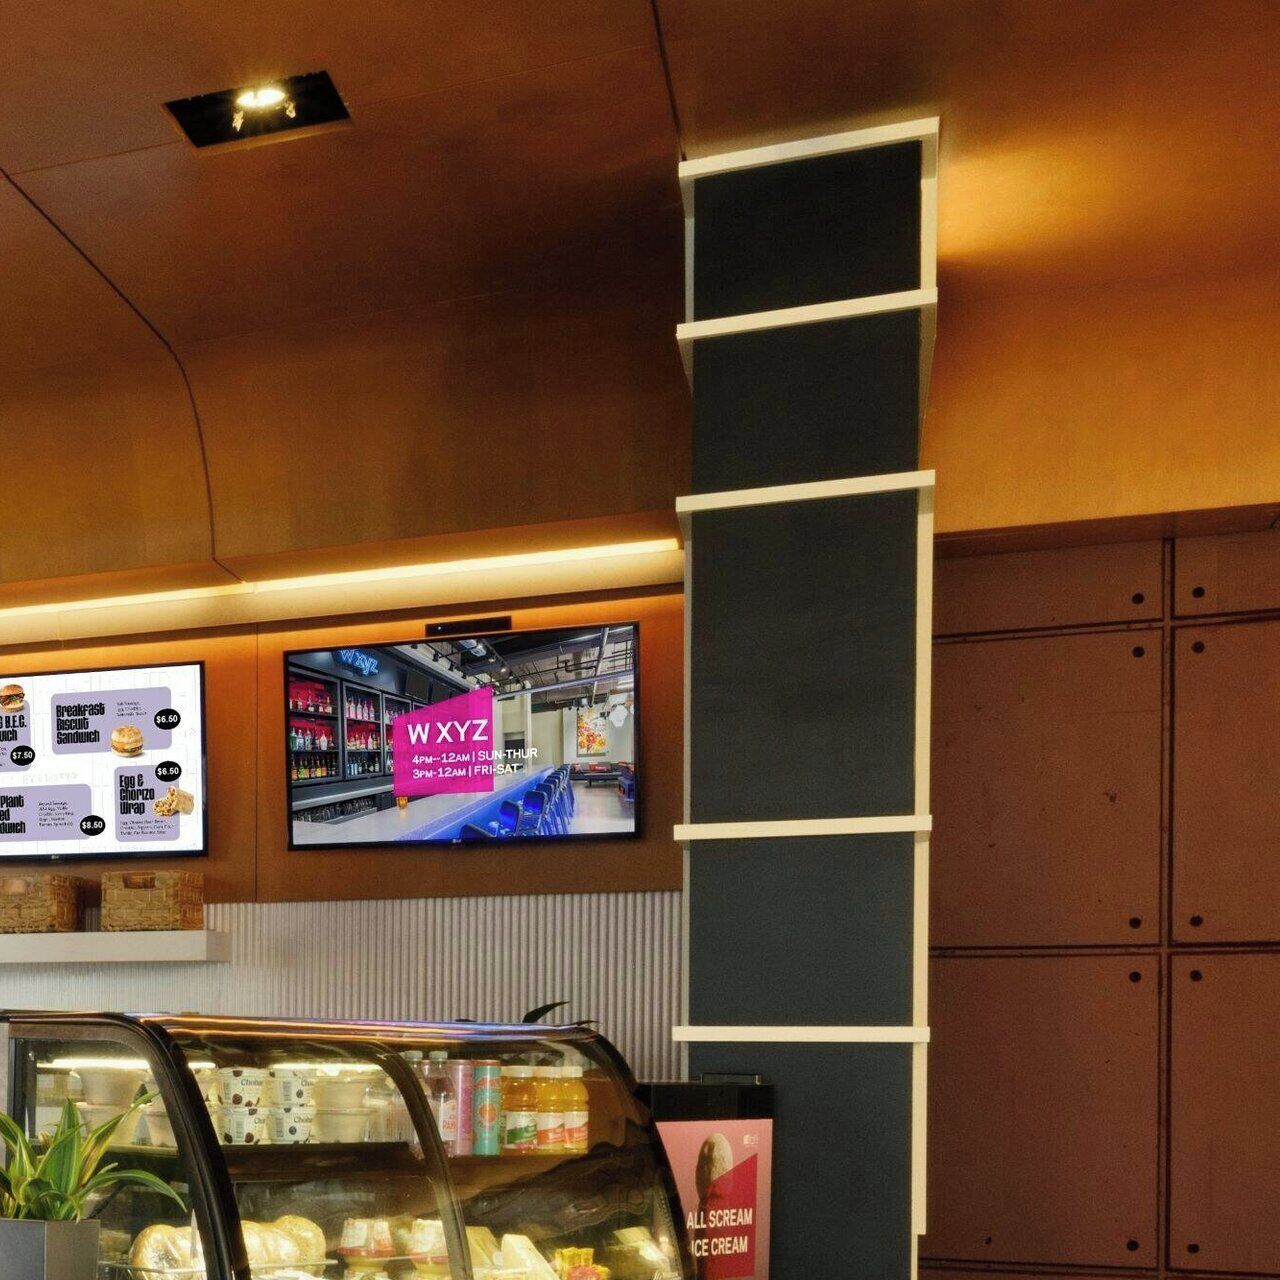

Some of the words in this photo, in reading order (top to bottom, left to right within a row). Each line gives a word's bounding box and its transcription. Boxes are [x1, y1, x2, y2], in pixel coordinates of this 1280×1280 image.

[56, 702, 106, 718] Breakfast
[5, 714, 27, 729] B.E.C.
[56, 716, 89, 731] Biscuit
[155, 714, 178, 724] $6.50
[56, 729, 100, 745] Sandwich
[407, 722, 430, 745] W
[435, 718, 489, 744] XYZ
[11, 750, 33, 760] $7.50
[477, 747, 538, 762] SUN-THUR
[156, 766, 179, 776] $6.50
[412, 766, 467, 780] 3PM-12AM
[473, 763, 519, 776] FRI-SAT
[119, 774, 136, 789] Egg
[137, 773, 144, 787] &
[0, 793, 25, 809] Plant
[119, 788, 155, 801] Chorizo
[119, 801, 146, 816] Wrap
[81, 820, 104, 831] $8.50
[686, 1211, 707, 1230] ALL
[708, 1207, 753, 1228] SCREAM
[691, 1238, 709, 1258] ICE
[710, 1235, 749, 1256] CREAM
